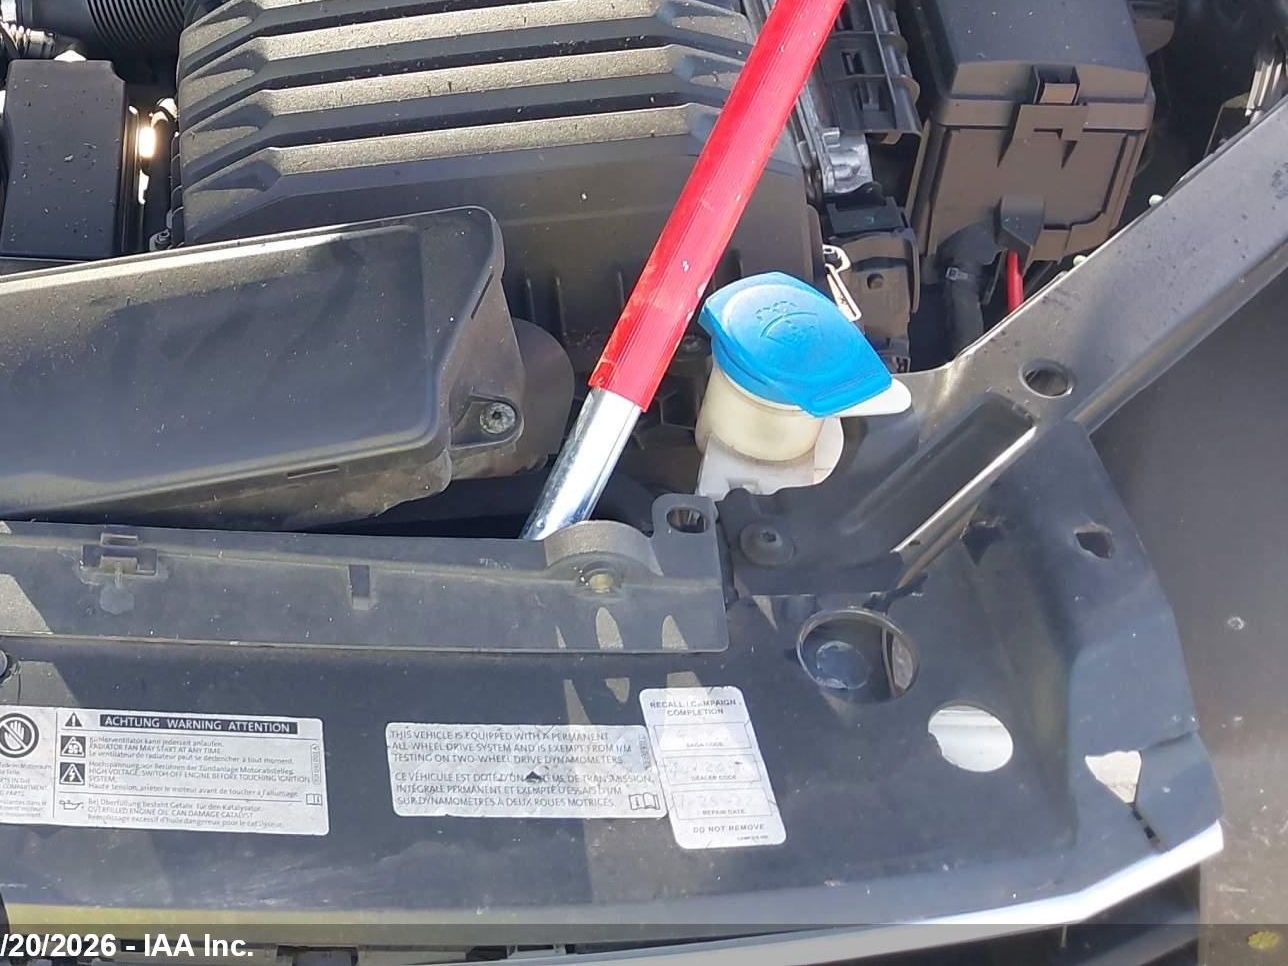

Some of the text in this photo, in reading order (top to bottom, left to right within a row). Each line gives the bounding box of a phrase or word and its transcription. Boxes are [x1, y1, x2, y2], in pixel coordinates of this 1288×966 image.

[649, 700, 684, 708] RECALL
[667, 708, 724, 717] COMPLETION
[104, 716, 160, 728] ACHTUNG
[167, 718, 222, 730] WARNING
[228, 721, 290, 733] ATTENTION
[391, 730, 412, 739] THIS
[413, 730, 453, 740] VEHICLE
[455, 731, 464, 739] IS
[465, 731, 512, 741] EQUIPPED
[513, 732, 541, 741] WITH
[551, 732, 608, 742] PERMANENT
[446, 743, 475, 752] DRIVE
[477, 743, 511, 753] SYSTEM
[513, 744, 535, 753] AND
[537, 744, 546, 753] IS
[548, 744, 584, 754] EXEMPT
[586, 744, 614, 753] FROM
[393, 753, 432, 762] TESTING
[434, 753, 450, 762] ON
[513, 755, 541, 764] DRIVE
[395, 772, 406, 781] CE
[455, 773, 470, 782] EST
[567, 774, 578, 783] DE
[447, 785, 502, 794] PERMANENT
[504, 785, 515, 794] ET
[397, 796, 416, 805] SUR
[506, 797, 532, 807] DEUX
[534, 797, 567, 807] ROUES
[188, 810, 220, 818] DAMAGE
[728, 824, 765, 832] REMOVE
